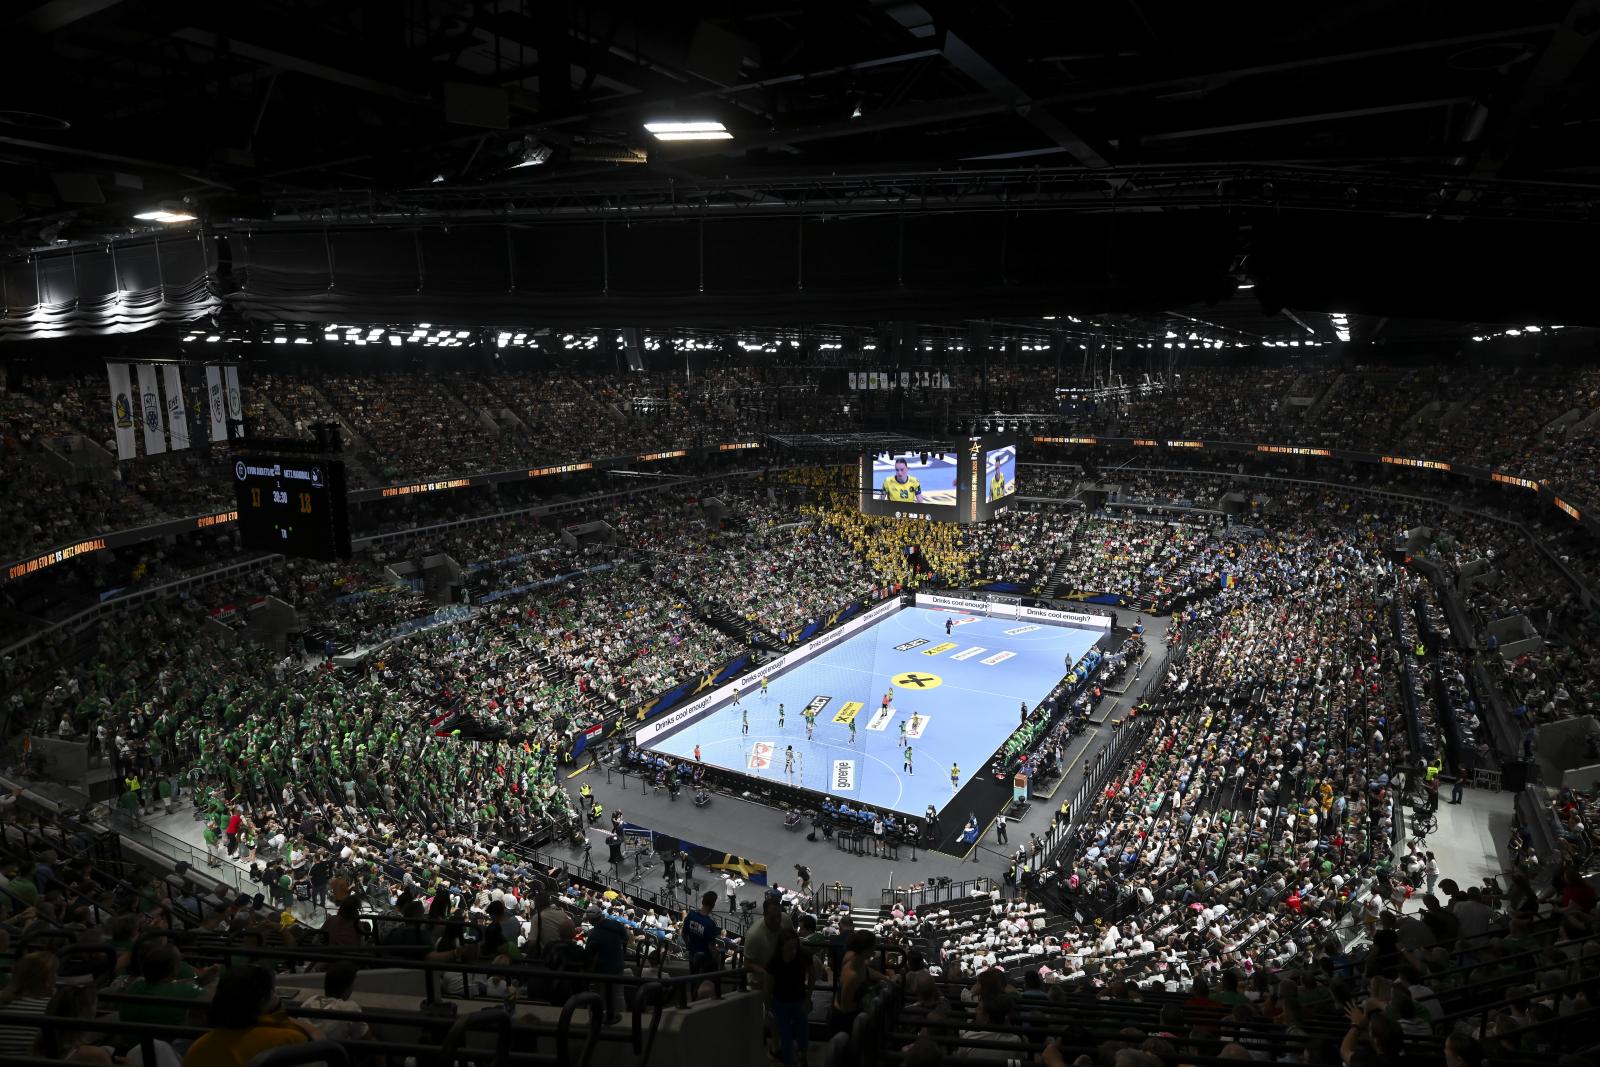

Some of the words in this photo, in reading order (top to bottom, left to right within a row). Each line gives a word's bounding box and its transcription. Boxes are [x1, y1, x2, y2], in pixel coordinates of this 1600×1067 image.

[435, 481, 447, 489] METZ
[48, 553, 56, 565] KC
[55, 550, 63, 562] VS
[62, 546, 75, 560] METZ
[74, 538, 106, 555] HANDBALL
[932, 596, 951, 605] Drinks
[1026, 608, 1047, 617] Drinks
[1047, 611, 1062, 619] cool
[1062, 614, 1091, 623] enough?
[741, 672, 757, 686] Drinks
[757, 666, 768, 678] cool
[767, 657, 786, 673] enough?
[655, 716, 675, 732] Drinks
[675, 708, 688, 721] cool
[688, 695, 712, 714] enough?
[836, 762, 851, 788] gorenje
